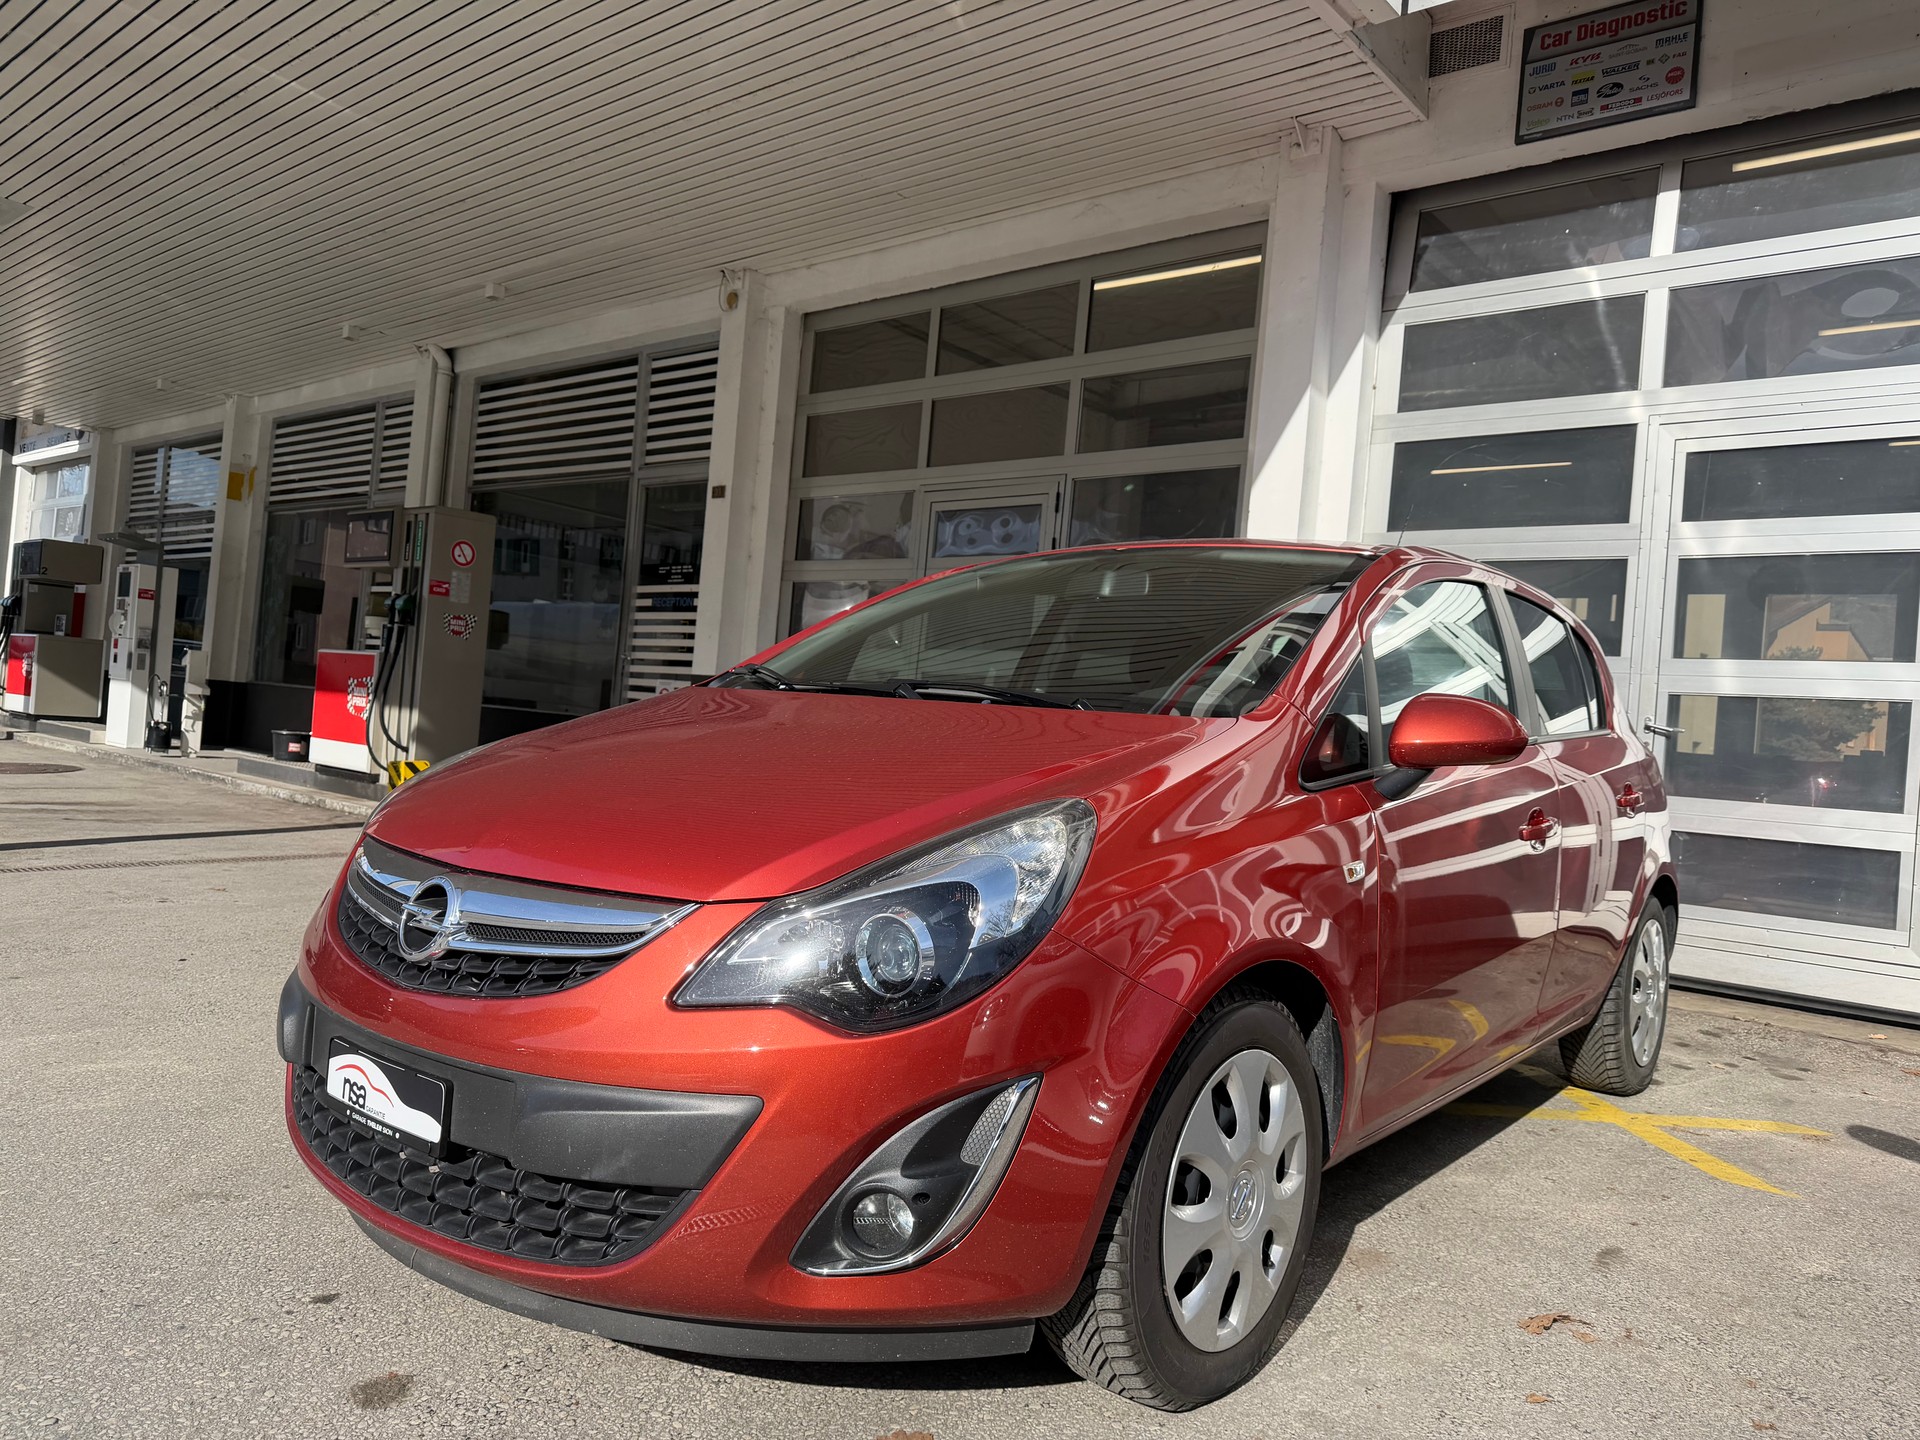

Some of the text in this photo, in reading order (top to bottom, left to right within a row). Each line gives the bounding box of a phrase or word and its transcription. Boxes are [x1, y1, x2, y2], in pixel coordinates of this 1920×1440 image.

[1540, 0, 1688, 51] Car Diagnostic
[1655, 32, 1689, 47] MAHLE
[1528, 61, 1557, 77] JURID
[1602, 61, 1641, 77] WALKER
[1538, 80, 1566, 92] VARTA
[1571, 75, 1596, 87] TEXTAR
[1629, 82, 1659, 92] SACHS
[1526, 101, 1553, 112] OSRAM
[1607, 99, 1635, 109] FERODO
[1556, 113, 1575, 123] NTN
[19, 432, 71, 454] VENTE SERVICE
[41, 566, 48, 575] 2
[450, 618, 466, 626] MINI
[449, 625, 466, 633] PRIX
[353, 687, 367, 696] MINI
[352, 697, 367, 707] PRIX
[342, 1077, 366, 1110] nsa
[352, 1112, 367, 1124] GARAGE
[382, 1127, 394, 1137] SION
